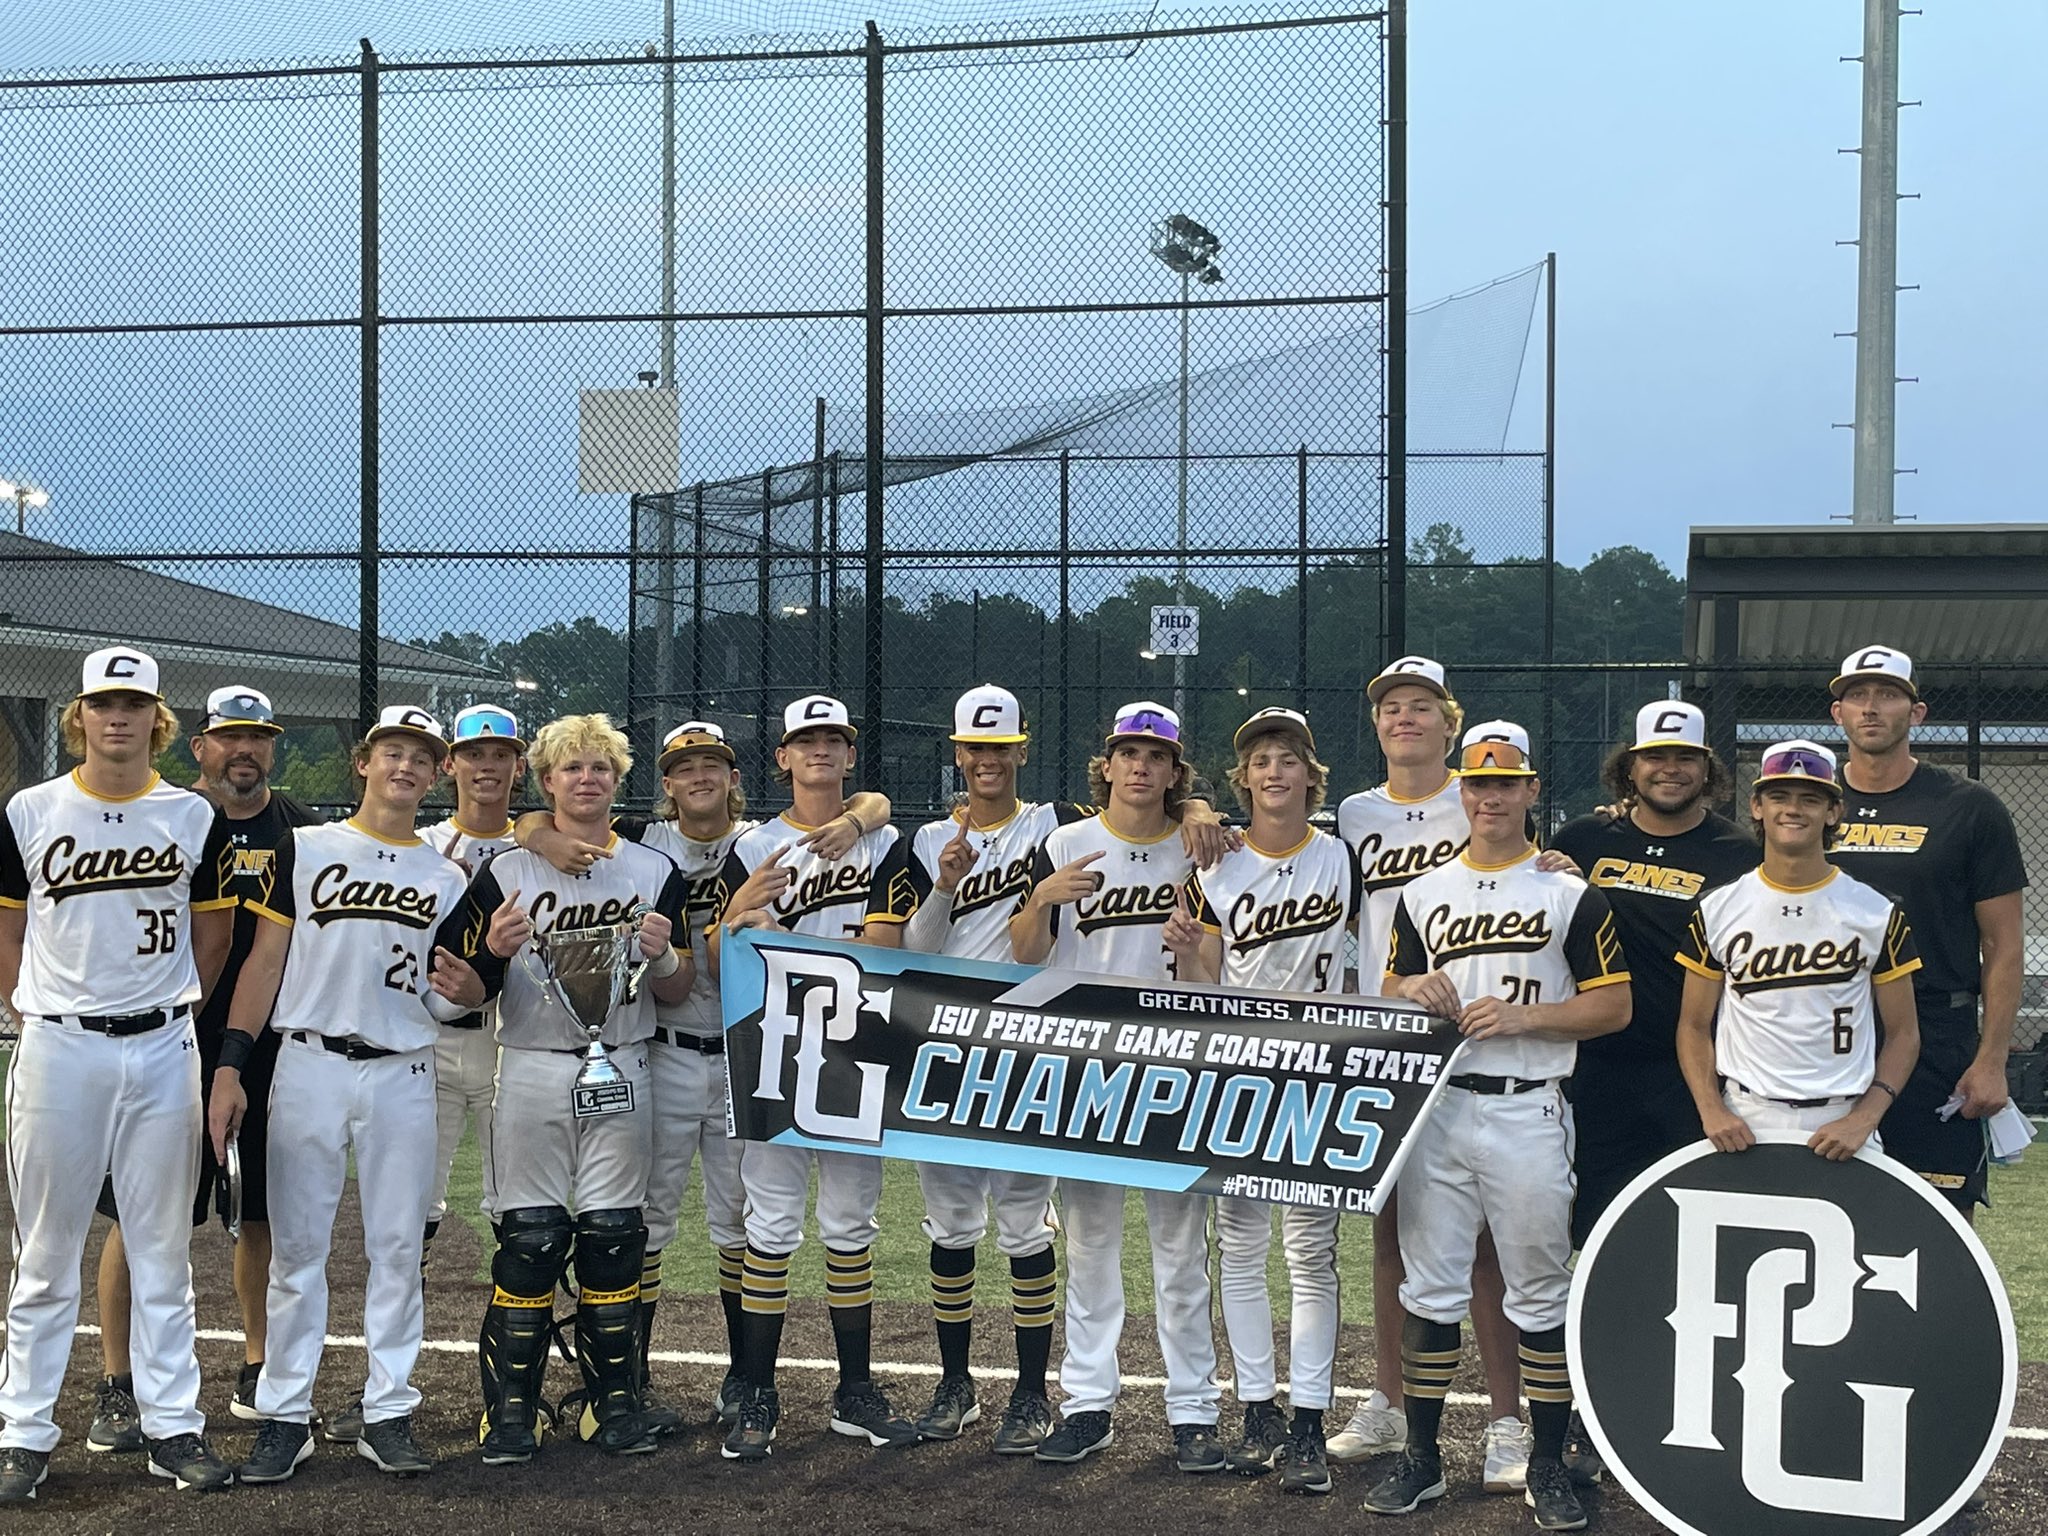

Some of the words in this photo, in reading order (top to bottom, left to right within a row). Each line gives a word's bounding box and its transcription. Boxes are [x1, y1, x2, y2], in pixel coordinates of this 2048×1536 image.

[1159, 615, 1192, 628] FIELD
[1170, 634, 1179, 648] 3
[104, 656, 141, 678] C
[1854, 650, 1892, 671] C
[399, 710, 432, 730] C
[803, 700, 834, 720] C
[971, 705, 1003, 728] C
[1653, 710, 1688, 733] C
[43, 835, 184, 888] Canes
[952, 846, 1036, 910] anes
[1589, 857, 1706, 897] CANES
[310, 863, 438, 919] Canes
[1075, 871, 1179, 919] Cane
[1229, 885, 1343, 941] Canes
[136, 908, 178, 955] 36
[1424, 904, 1552, 955] Canes
[1314, 953, 1333, 993] 9
[1722, 931, 1868, 985] Canes
[1138, 990, 1294, 1022] GREATNESS.
[1302, 1005, 1433, 1035] ACHIEVED.
[1832, 1006, 1854, 1055] 6
[751, 948, 894, 1142] PG
[982, 1010, 1111, 1051] PERFECT
[1114, 1022, 1201, 1060] GAME
[1204, 1032, 1334, 1075] COASTAL
[1342, 1046, 1443, 1085] STATE
[900, 1040, 1396, 1173] CHAMPIONS
[1222, 1173, 1344, 1209] #PGTOURNEY
[1346, 1187, 1375, 1213] CH
[496, 1294, 553, 1305] EASTON
[583, 1289, 638, 1301] EASTON
[1661, 1187, 1919, 1521] PG
